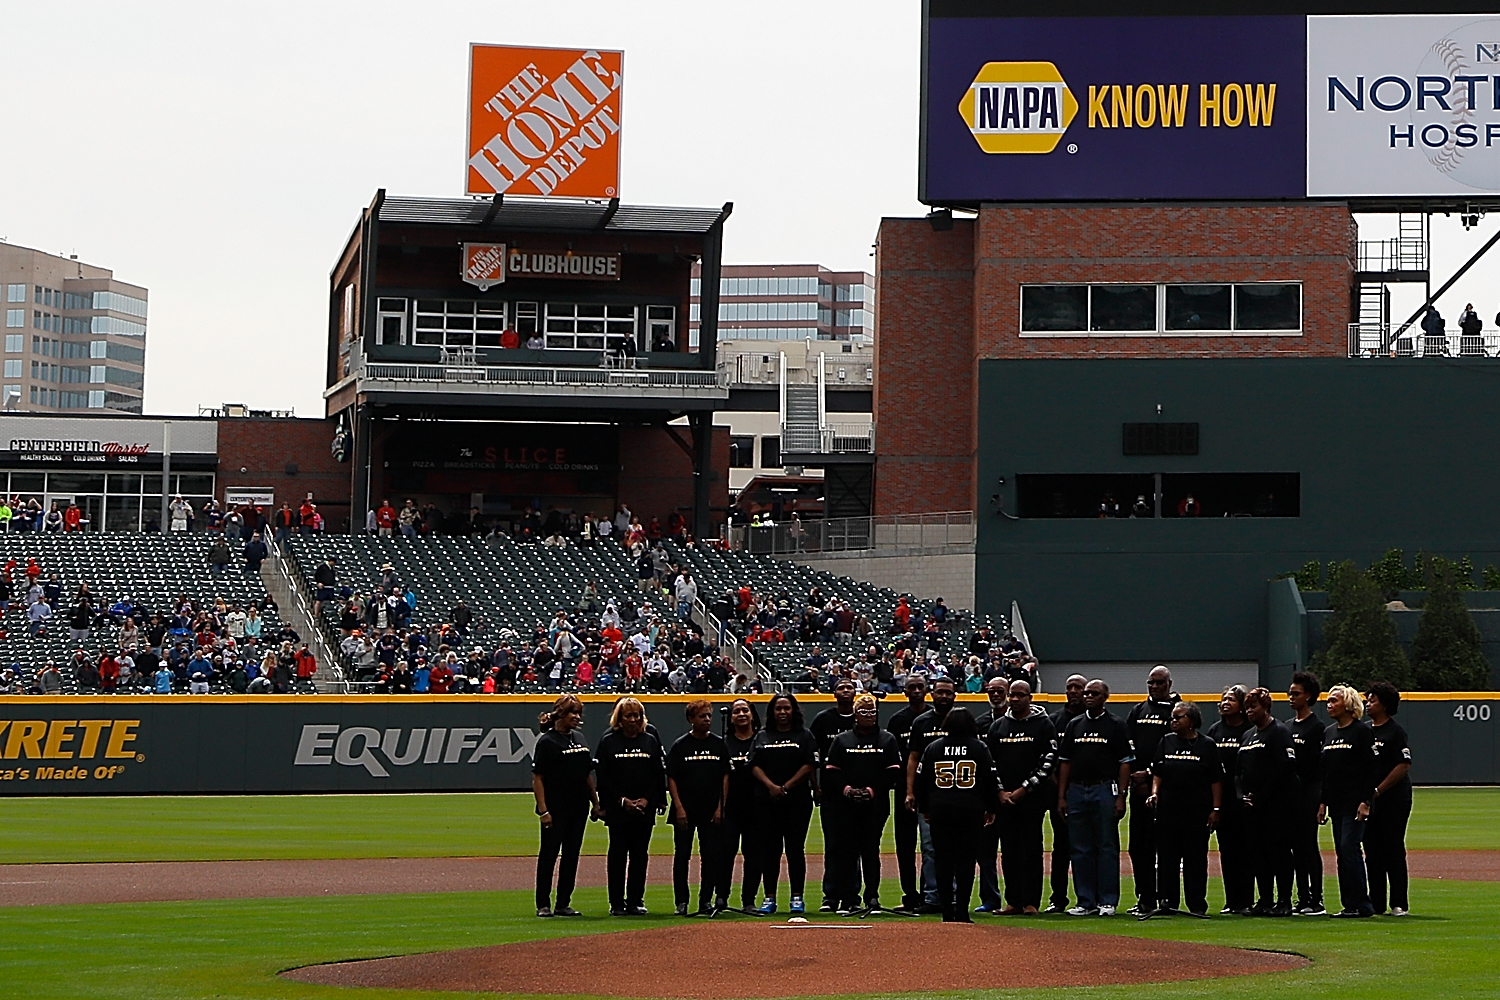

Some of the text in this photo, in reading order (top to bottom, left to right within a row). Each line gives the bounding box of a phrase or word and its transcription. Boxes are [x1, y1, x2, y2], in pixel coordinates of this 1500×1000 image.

[483, 62, 549, 121] THE
[978, 83, 1277, 129] NAPA KNOW HOW
[468, 50, 622, 193] HOME
[527, 105, 619, 196] DEPOT
[466, 245, 503, 280] HOME
[471, 250, 486, 264] THE
[509, 253, 617, 276] CLUBHOUSE
[10, 439, 101, 453] CENTERFIELD
[484, 446, 568, 464] SLICE
[412, 461, 436, 469] PIZZA
[549, 463, 570, 471] COLD
[571, 463, 599, 472] DRINKS
[1453, 704, 1491, 721] 400
[294, 725, 543, 777] EQUIFAX
[944, 745, 968, 756] KING
[35, 765, 88, 780] Made
[934, 760, 977, 789] 50
